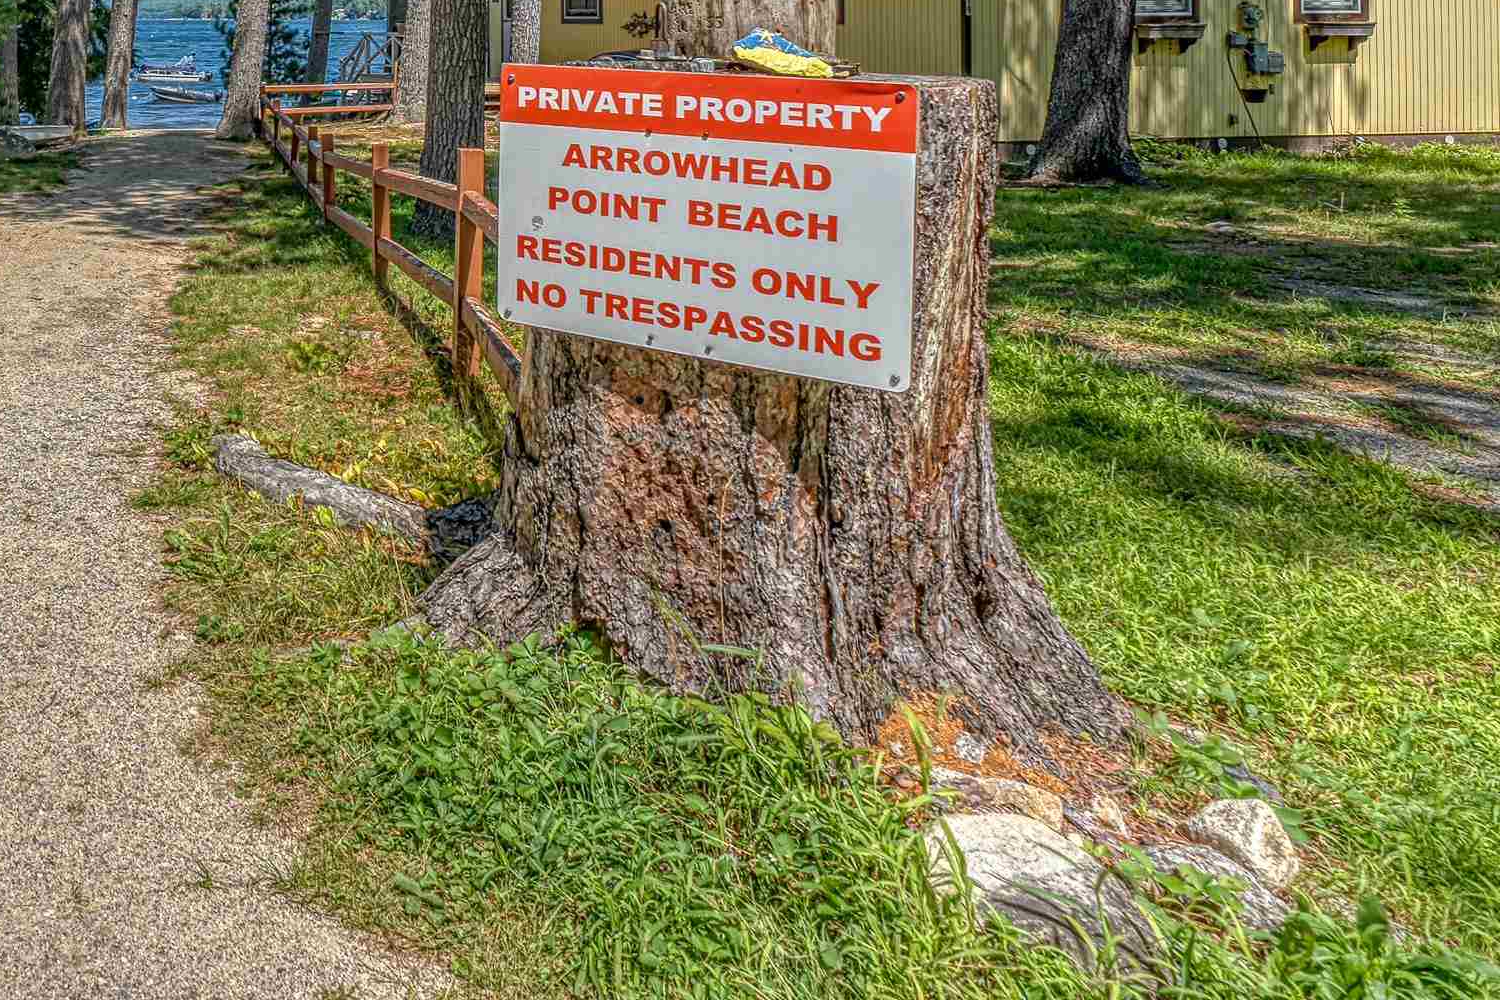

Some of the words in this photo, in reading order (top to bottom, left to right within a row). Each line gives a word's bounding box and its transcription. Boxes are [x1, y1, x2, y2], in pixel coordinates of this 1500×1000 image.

[517, 86, 663, 117] PRIVATE
[675, 95, 891, 132] PROPERTY
[562, 143, 832, 192] ARROWHEAD
[548, 186, 667, 223] POINT
[688, 199, 838, 242] BEACH
[516, 234, 737, 289] RESIDENTS
[751, 267, 879, 310] ONLY
[516, 279, 568, 309] NO
[580, 289, 882, 361] TRESPASSING
